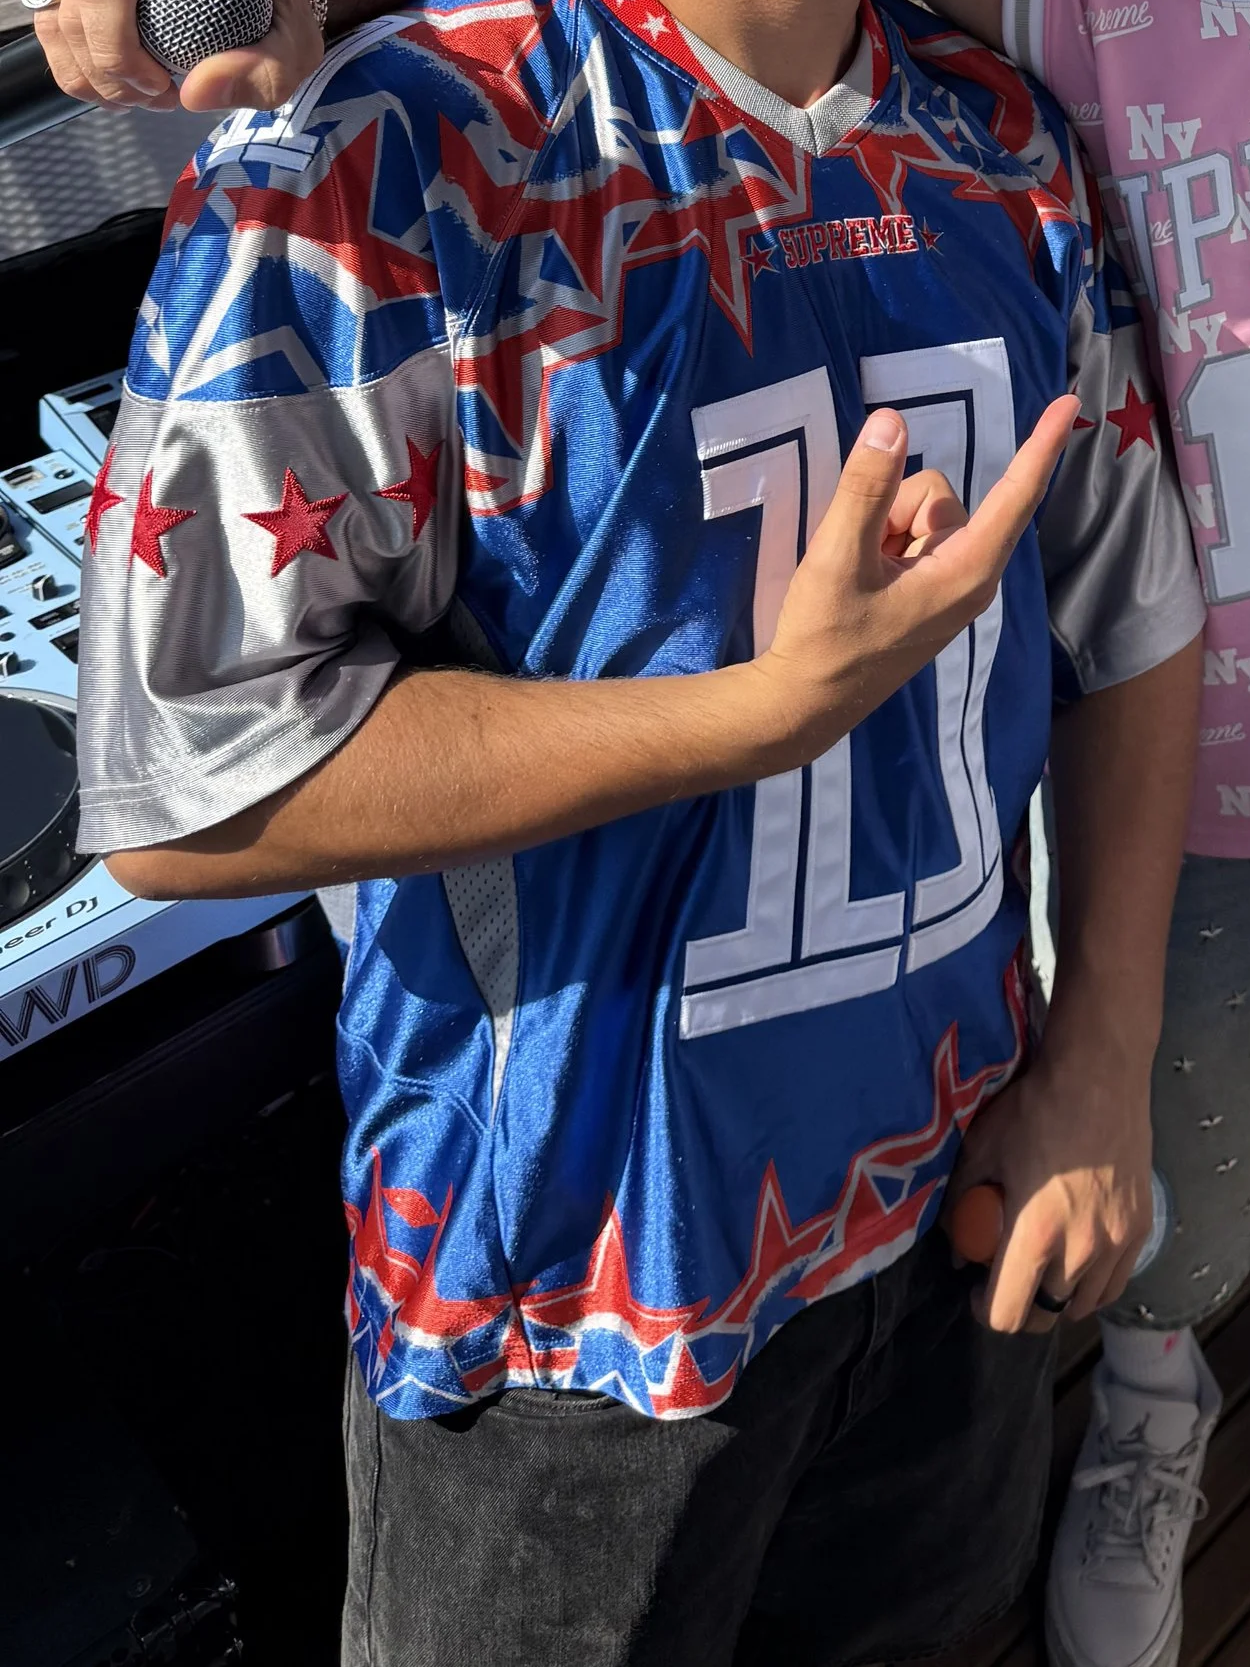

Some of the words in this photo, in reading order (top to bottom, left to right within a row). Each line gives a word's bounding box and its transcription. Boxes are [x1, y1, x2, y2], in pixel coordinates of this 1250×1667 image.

[1079, 0, 1154, 46] preme
[1126, 103, 1202, 161] NY
[778, 214, 920, 269] SUPREME
[65, 896, 99, 919] DJ
